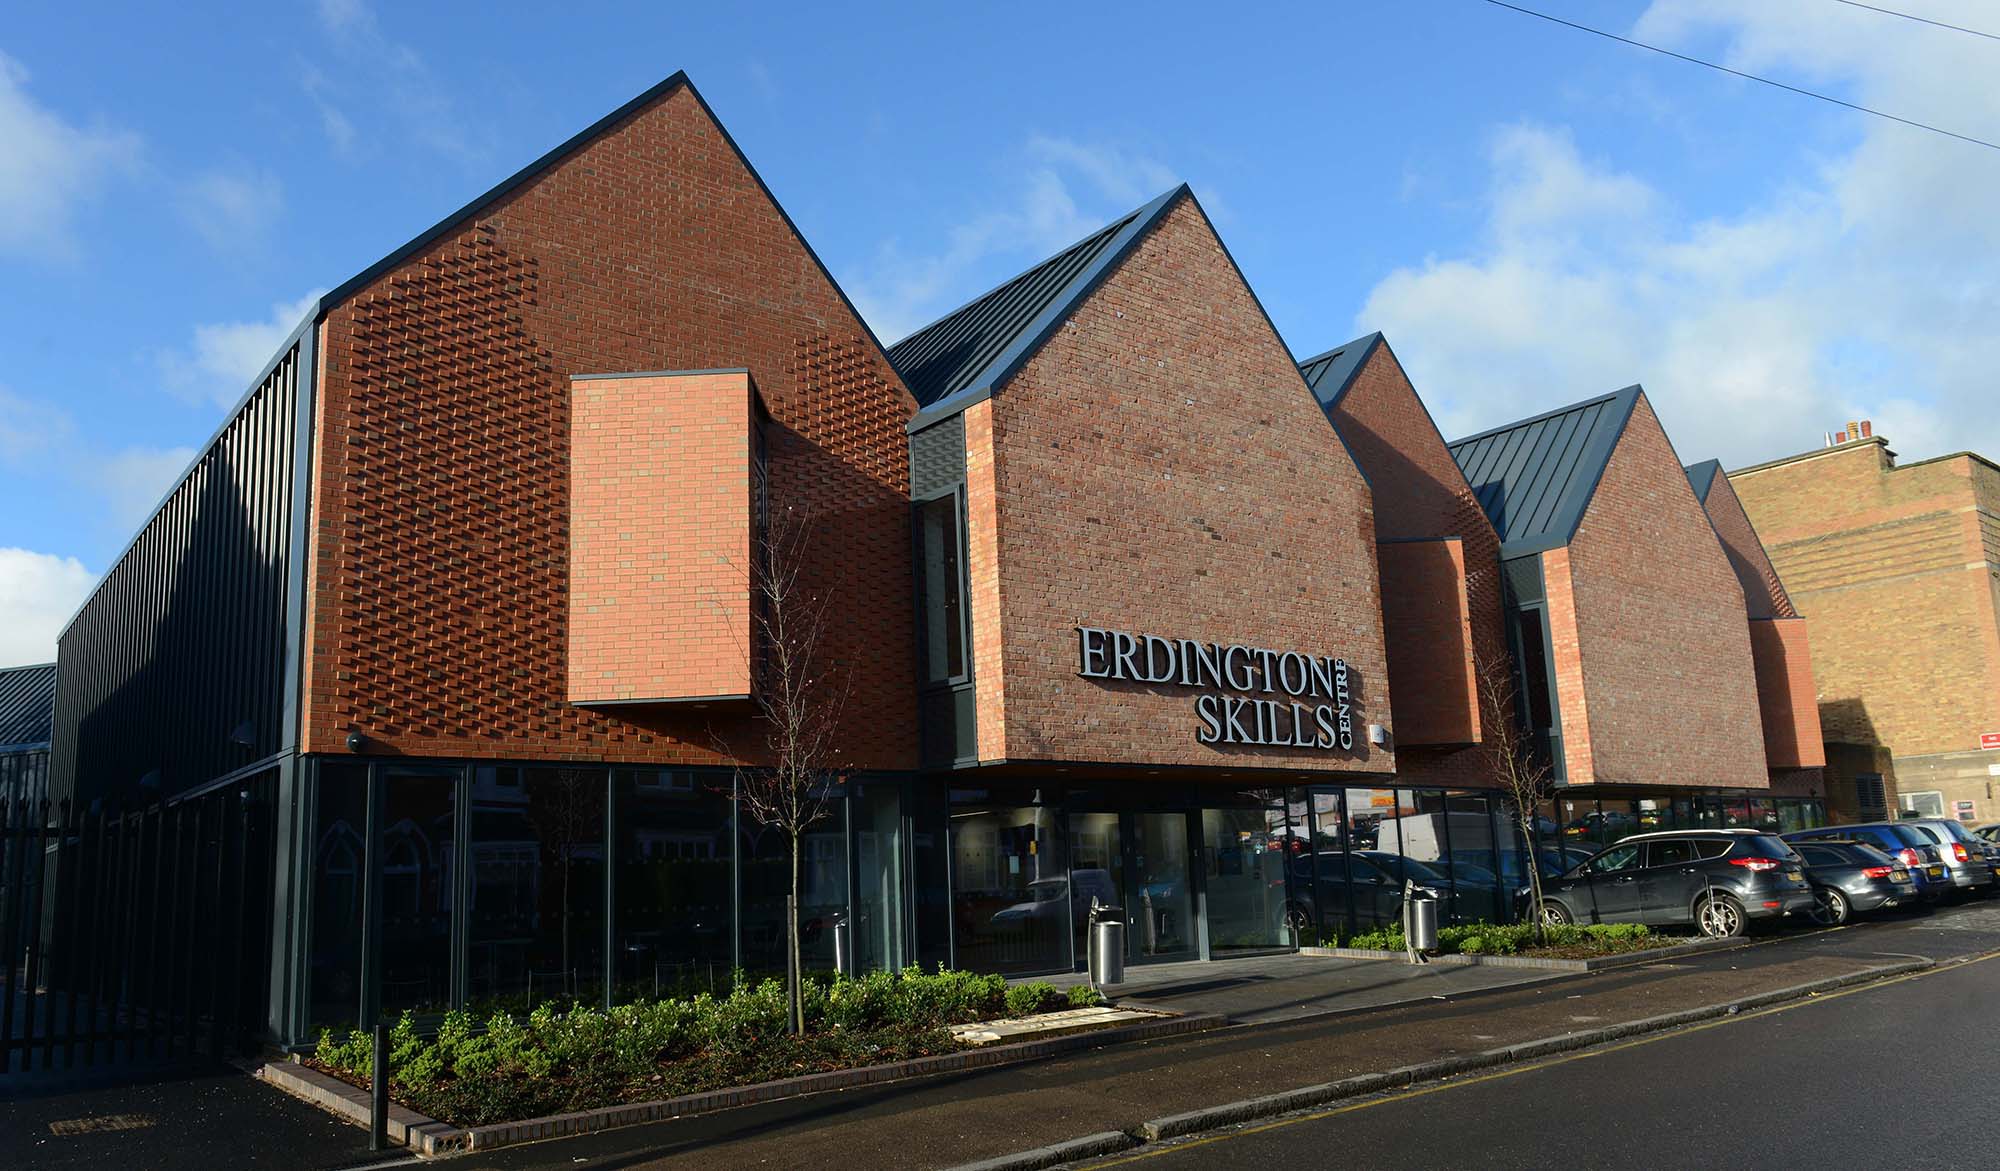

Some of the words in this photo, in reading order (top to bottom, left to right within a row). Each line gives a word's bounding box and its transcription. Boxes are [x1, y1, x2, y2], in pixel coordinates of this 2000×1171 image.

[1077, 627, 1334, 699] ERDINGTON
[1197, 695, 1337, 750] SKILLS
[1335, 658, 1352, 750] CENTRE
